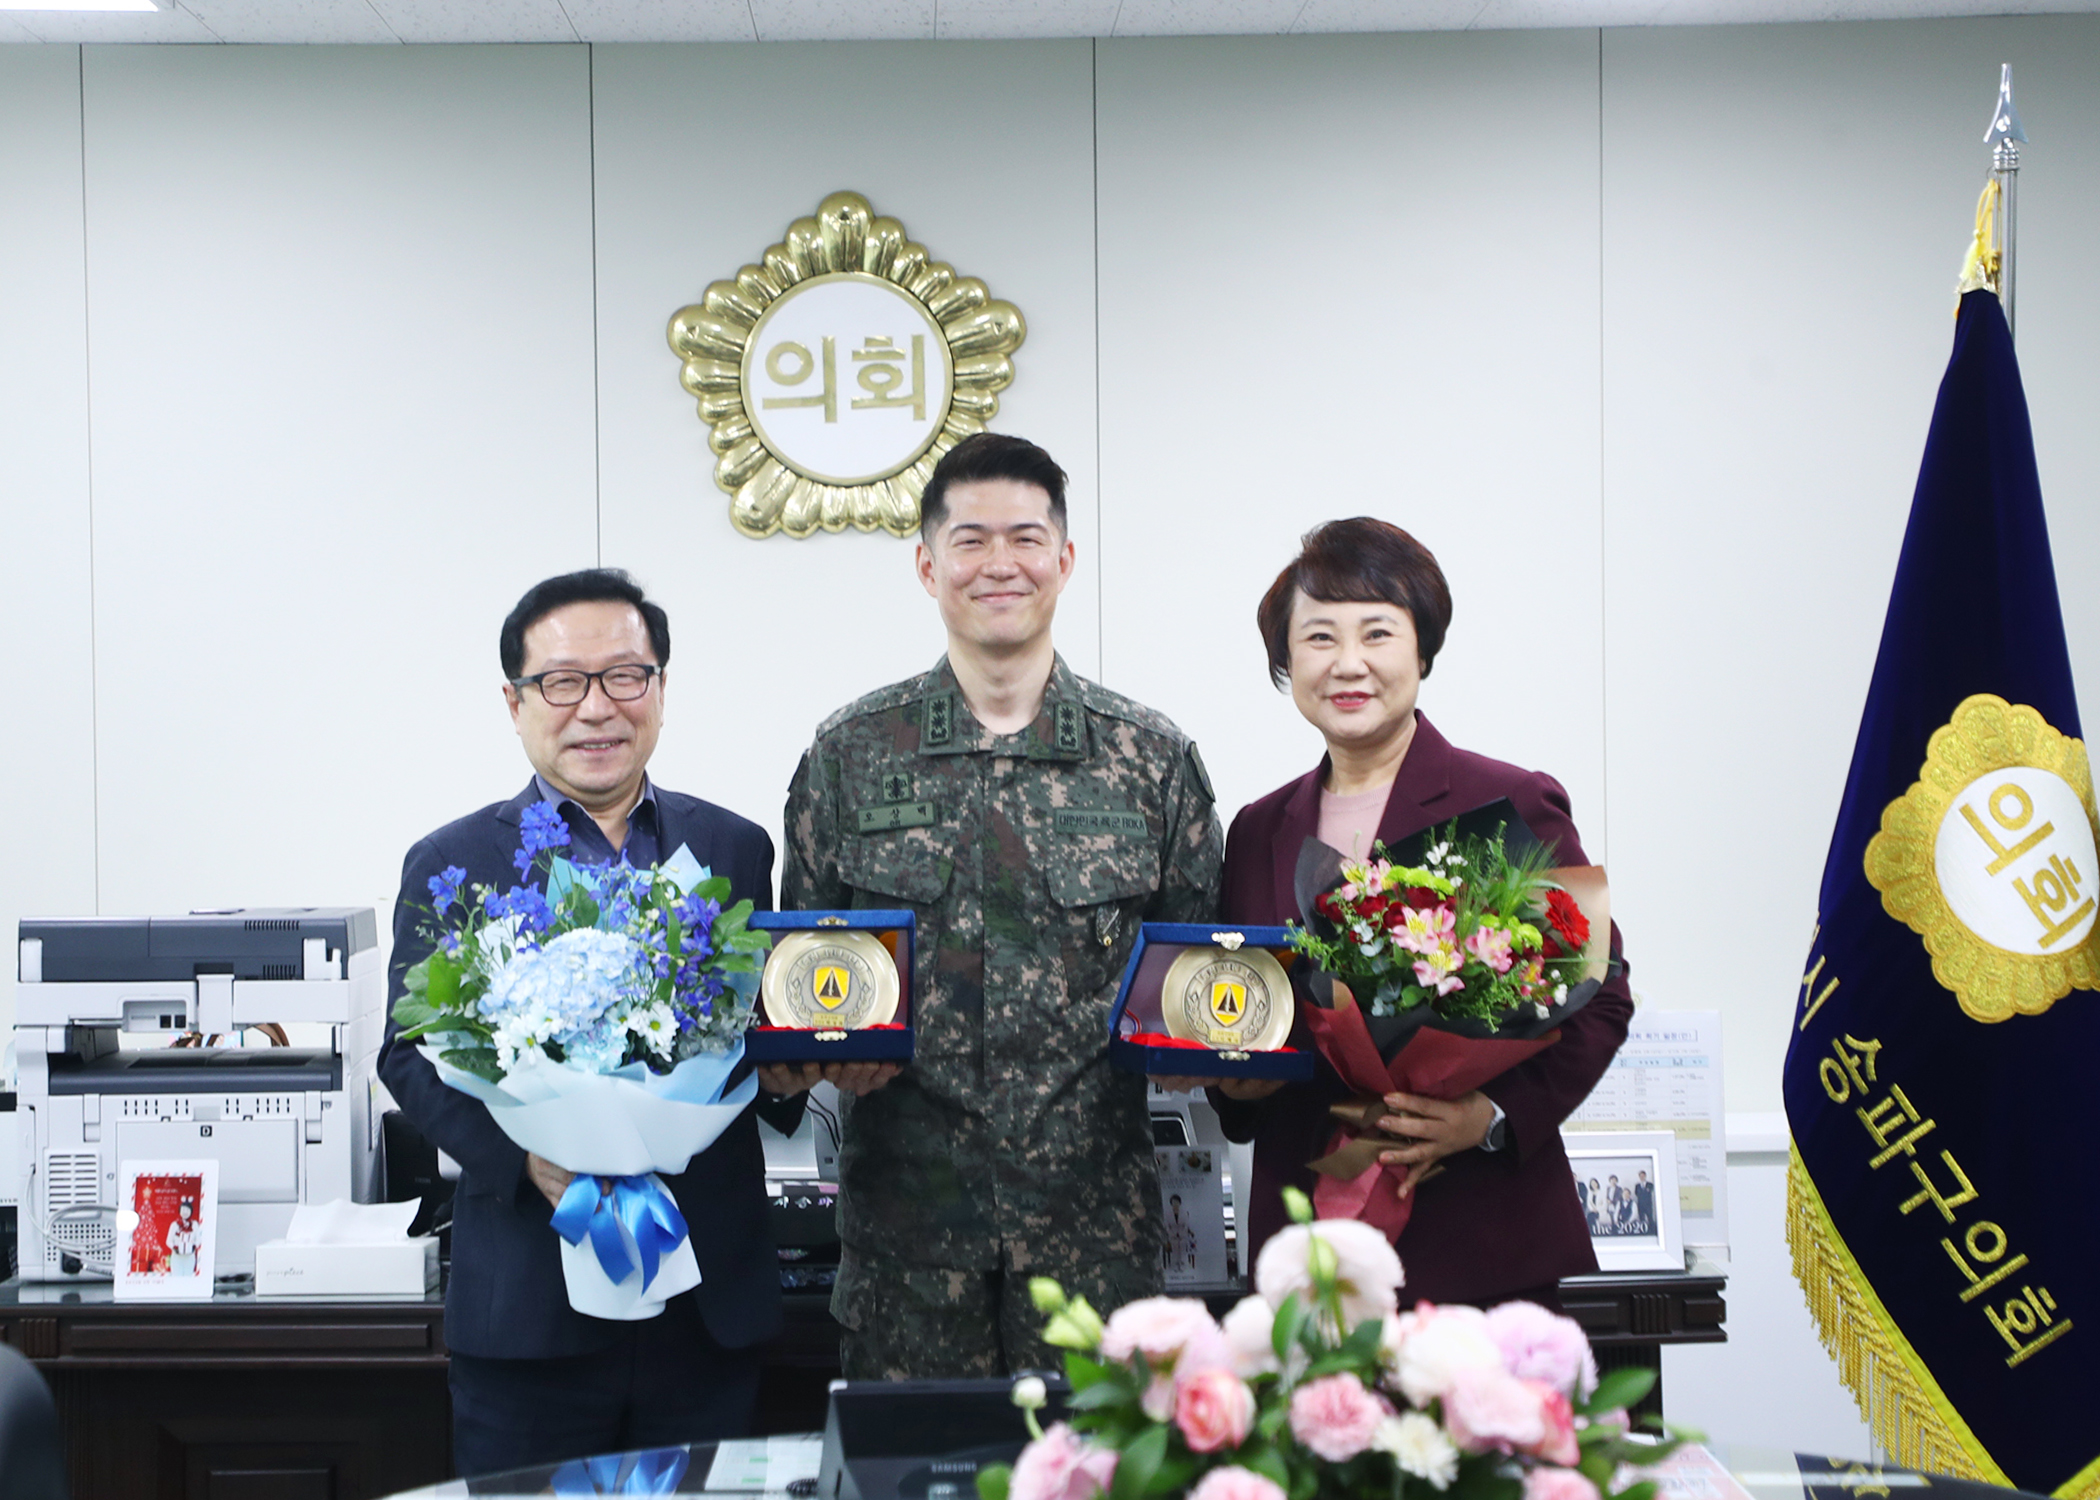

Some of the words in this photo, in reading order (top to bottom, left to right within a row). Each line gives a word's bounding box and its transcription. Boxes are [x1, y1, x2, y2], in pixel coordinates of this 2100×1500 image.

[762, 334, 926, 424] 의회
[1959, 782, 2096, 950] 의회
[1800, 925, 1841, 1032] 시
[1617, 1221, 1649, 1235] 2020
[1819, 1032, 2074, 1369] 송파구의회
[931, 1461, 977, 1474] SAMSUNG
